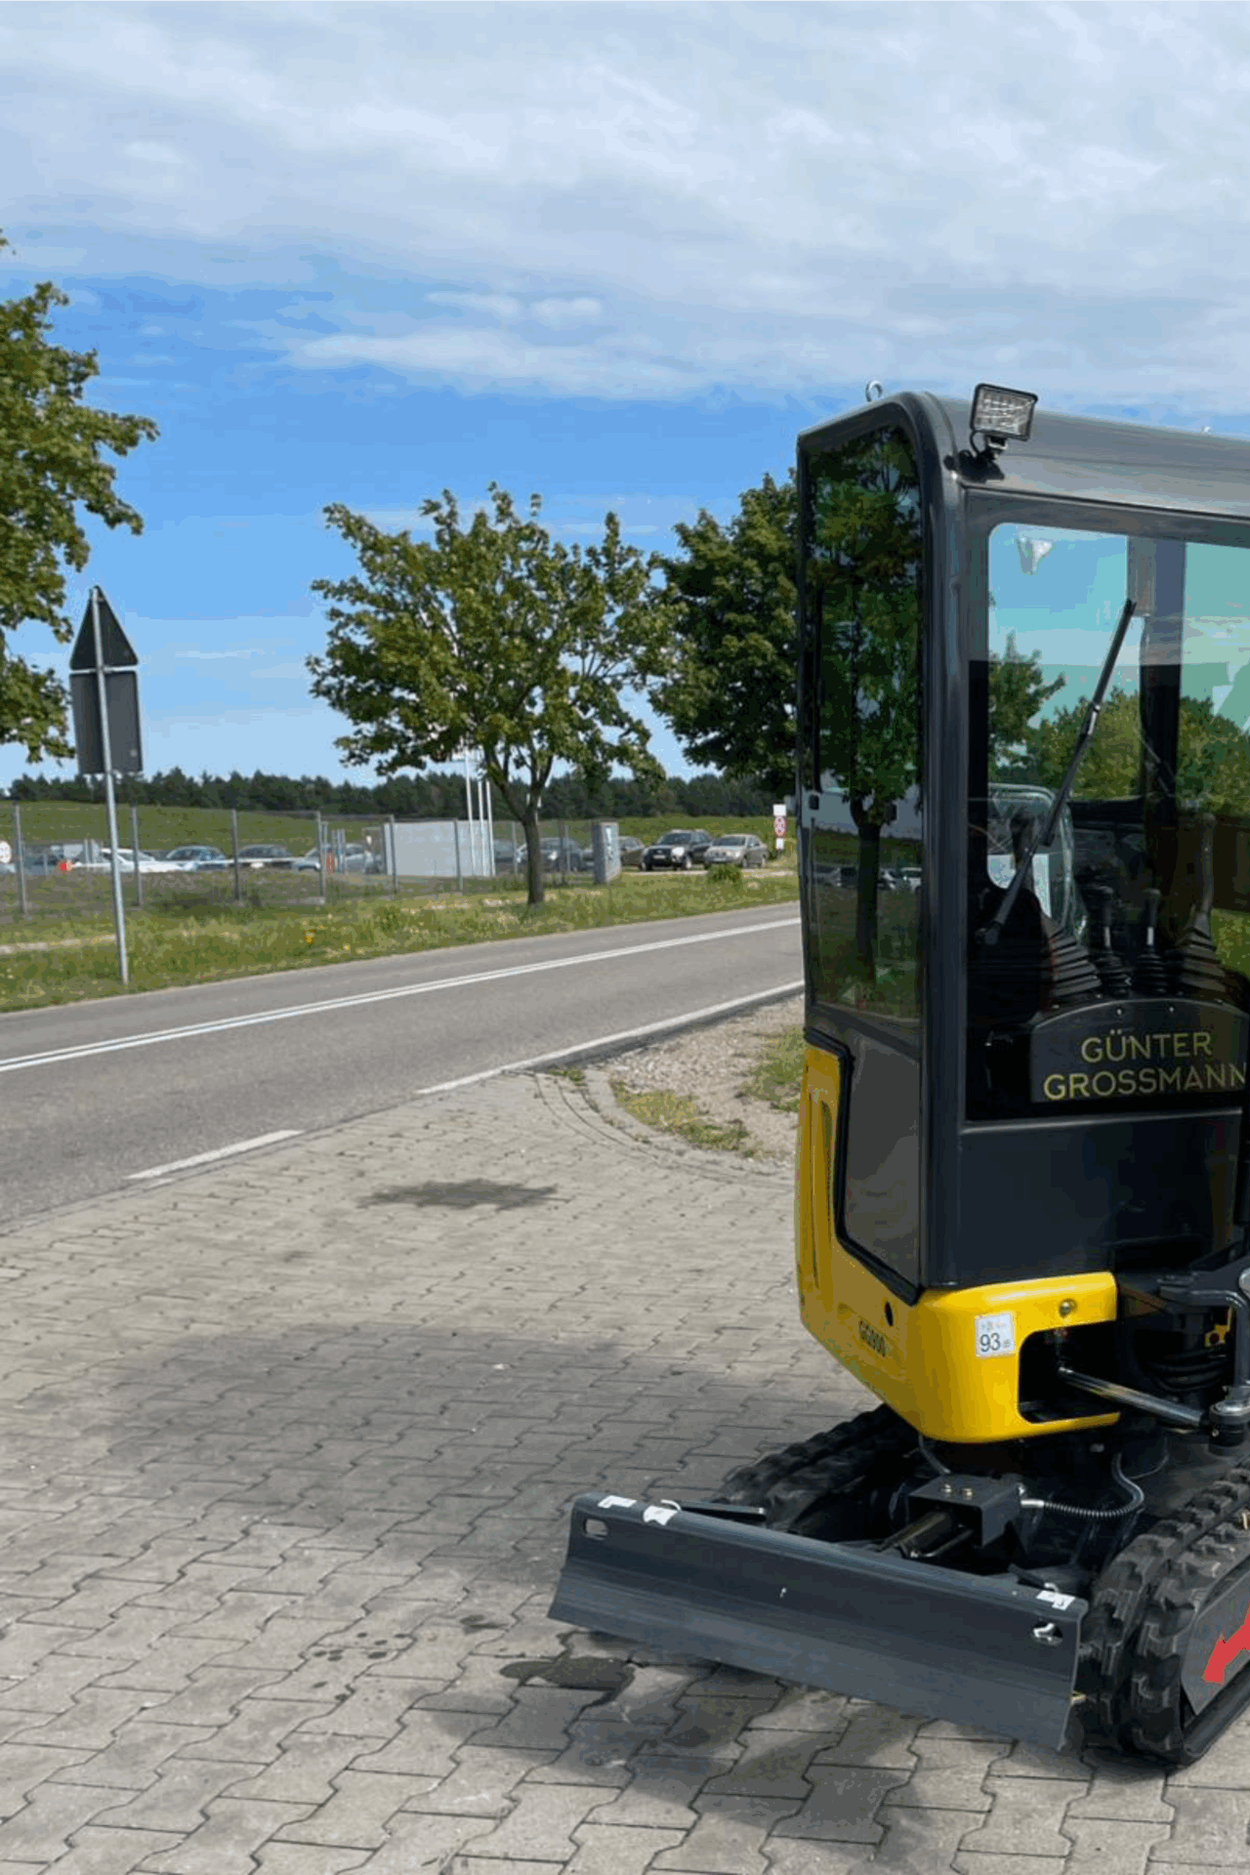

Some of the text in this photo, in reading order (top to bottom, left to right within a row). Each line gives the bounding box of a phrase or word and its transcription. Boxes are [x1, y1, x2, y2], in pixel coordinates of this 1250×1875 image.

[1081, 1029, 1212, 1063] GÜNTER
[1043, 1062, 1247, 1100] GROSSMANN
[980, 1333, 1000, 1352] 93
